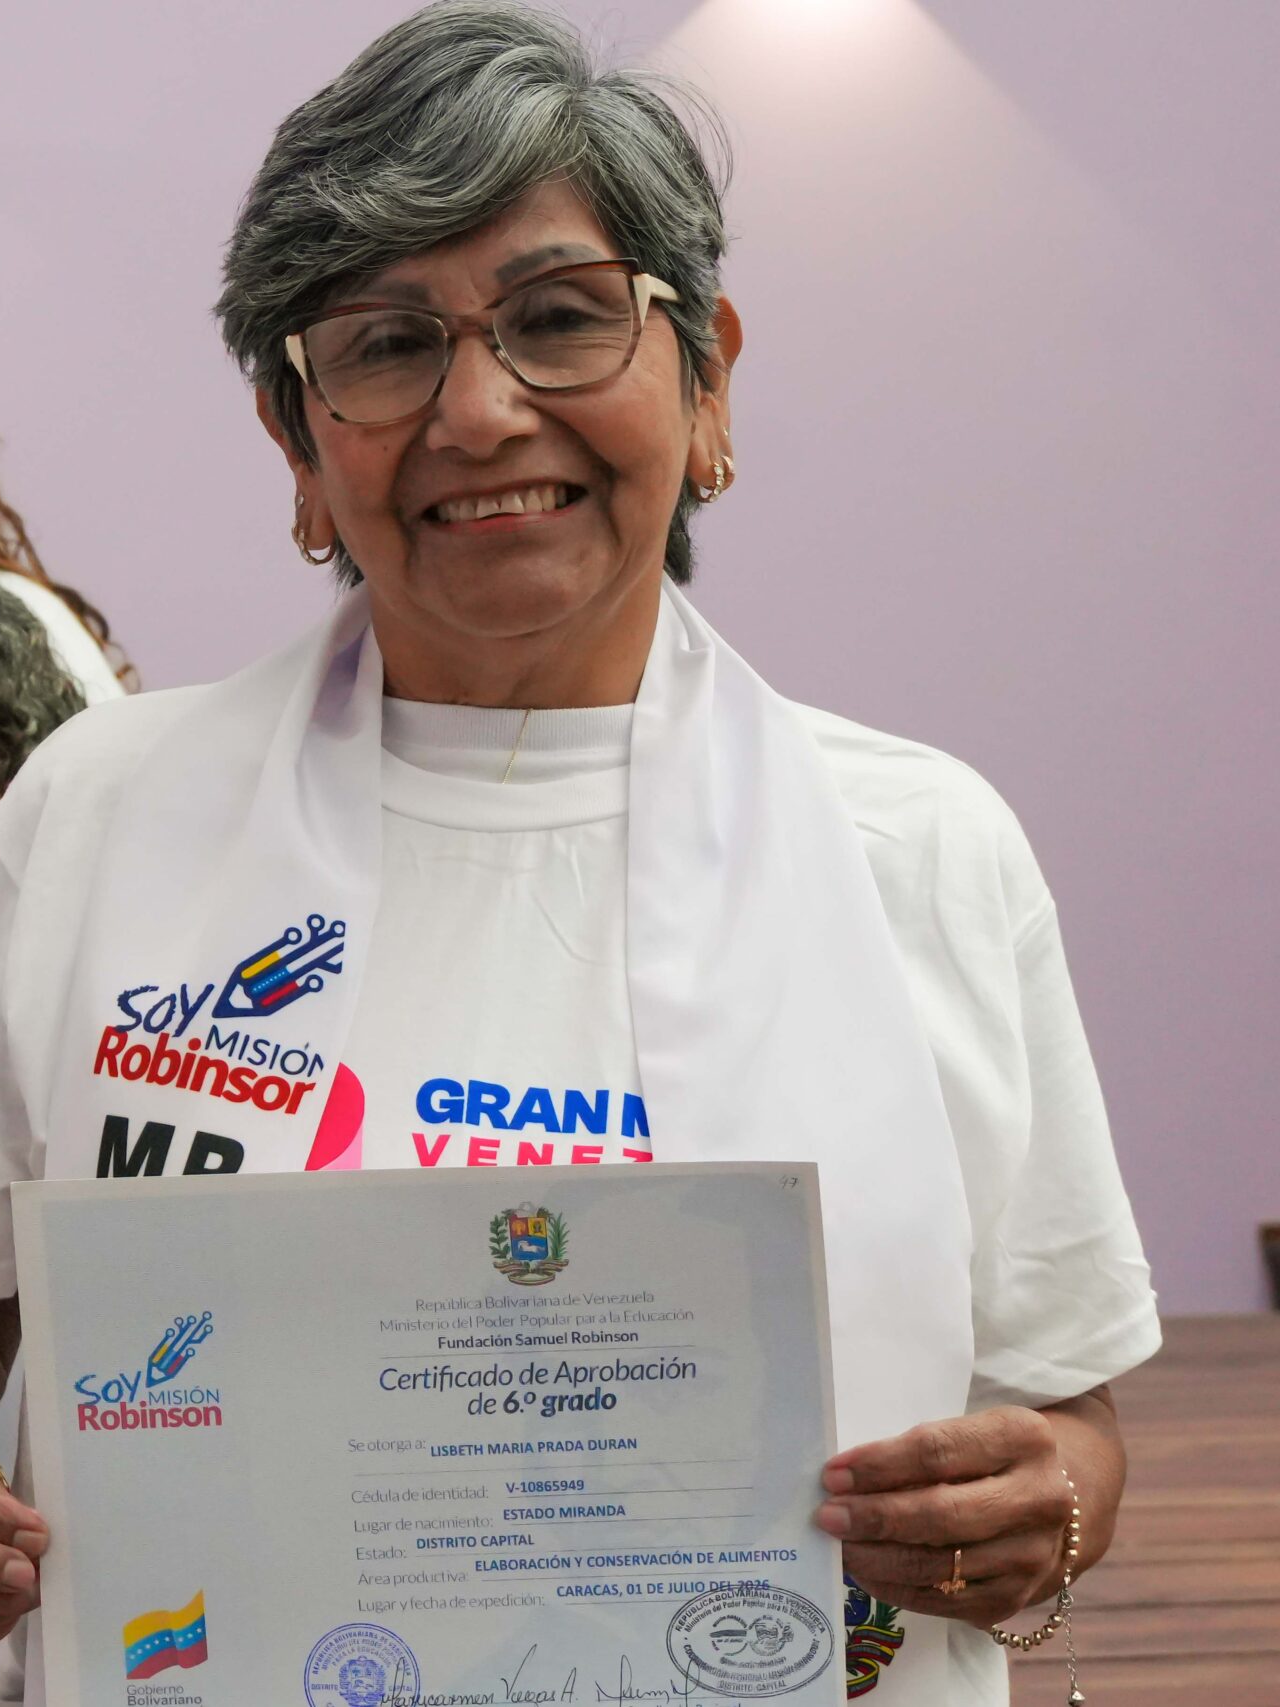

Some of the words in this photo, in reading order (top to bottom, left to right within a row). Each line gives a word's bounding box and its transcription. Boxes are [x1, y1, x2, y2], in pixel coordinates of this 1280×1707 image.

[416, 1078, 609, 1134] GRAN
[415, 1296, 482, 1312] República
[485, 1294, 561, 1309] Bolivariana
[562, 1294, 580, 1306] de
[583, 1290, 654, 1305] Venezuela
[380, 1317, 450, 1332] Ministerio
[452, 1316, 473, 1329] del
[476, 1314, 515, 1328] Poder
[520, 1312, 570, 1328] Popular
[576, 1314, 605, 1327] para
[609, 1311, 620, 1323] la
[624, 1309, 694, 1323] Educación
[438, 1334, 512, 1350] Fundación
[515, 1332, 568, 1346] Samuel
[571, 1330, 639, 1344] Robinson
[379, 1364, 513, 1392] Certificado
[519, 1361, 549, 1384] de
[553, 1356, 697, 1388] Aprobación
[148, 1385, 220, 1406] MISIÓN
[468, 1392, 497, 1415] de
[540, 1386, 618, 1417] grado
[77, 1401, 222, 1431] Robinson
[348, 1439, 366, 1453] Se
[367, 1438, 412, 1453] otorga
[414, 1439, 426, 1450] a:
[431, 1444, 484, 1457] LISBETH
[488, 1442, 534, 1455] MARIA
[538, 1440, 584, 1453] PRADA
[588, 1438, 637, 1451] DURAN
[351, 1488, 400, 1504] Cédula
[402, 1487, 419, 1501] de
[422, 1485, 489, 1501] identidad:
[505, 1479, 585, 1493] V-10865949
[503, 1508, 555, 1520] ESTADO
[559, 1505, 626, 1518] MIRANDA
[354, 1519, 390, 1535] Lugar
[395, 1516, 412, 1530] de
[415, 1515, 494, 1530] nacimiento:
[416, 1535, 477, 1549] DISTRITO
[481, 1534, 535, 1547] CAPITAL
[356, 1546, 407, 1561] Estado:
[475, 1555, 571, 1571] ELABORACIÓN
[575, 1557, 582, 1567] Y
[587, 1550, 693, 1568] CONSERVACIÓN
[697, 1552, 714, 1564] DE
[718, 1549, 797, 1563] ALIMENTOS
[393, 1570, 468, 1587] productiva:
[556, 1584, 622, 1598] CARACAS,
[626, 1583, 642, 1595] 01
[647, 1582, 664, 1594] DE
[668, 1581, 705, 1594] JULIO
[709, 1580, 733, 1592] DEL
[358, 1599, 395, 1614] Lugar
[401, 1601, 409, 1612] y
[410, 1596, 447, 1610] fecha
[449, 1595, 467, 1608] de
[468, 1593, 545, 1610] expedición:
[127, 1684, 184, 1696] Gobierno
